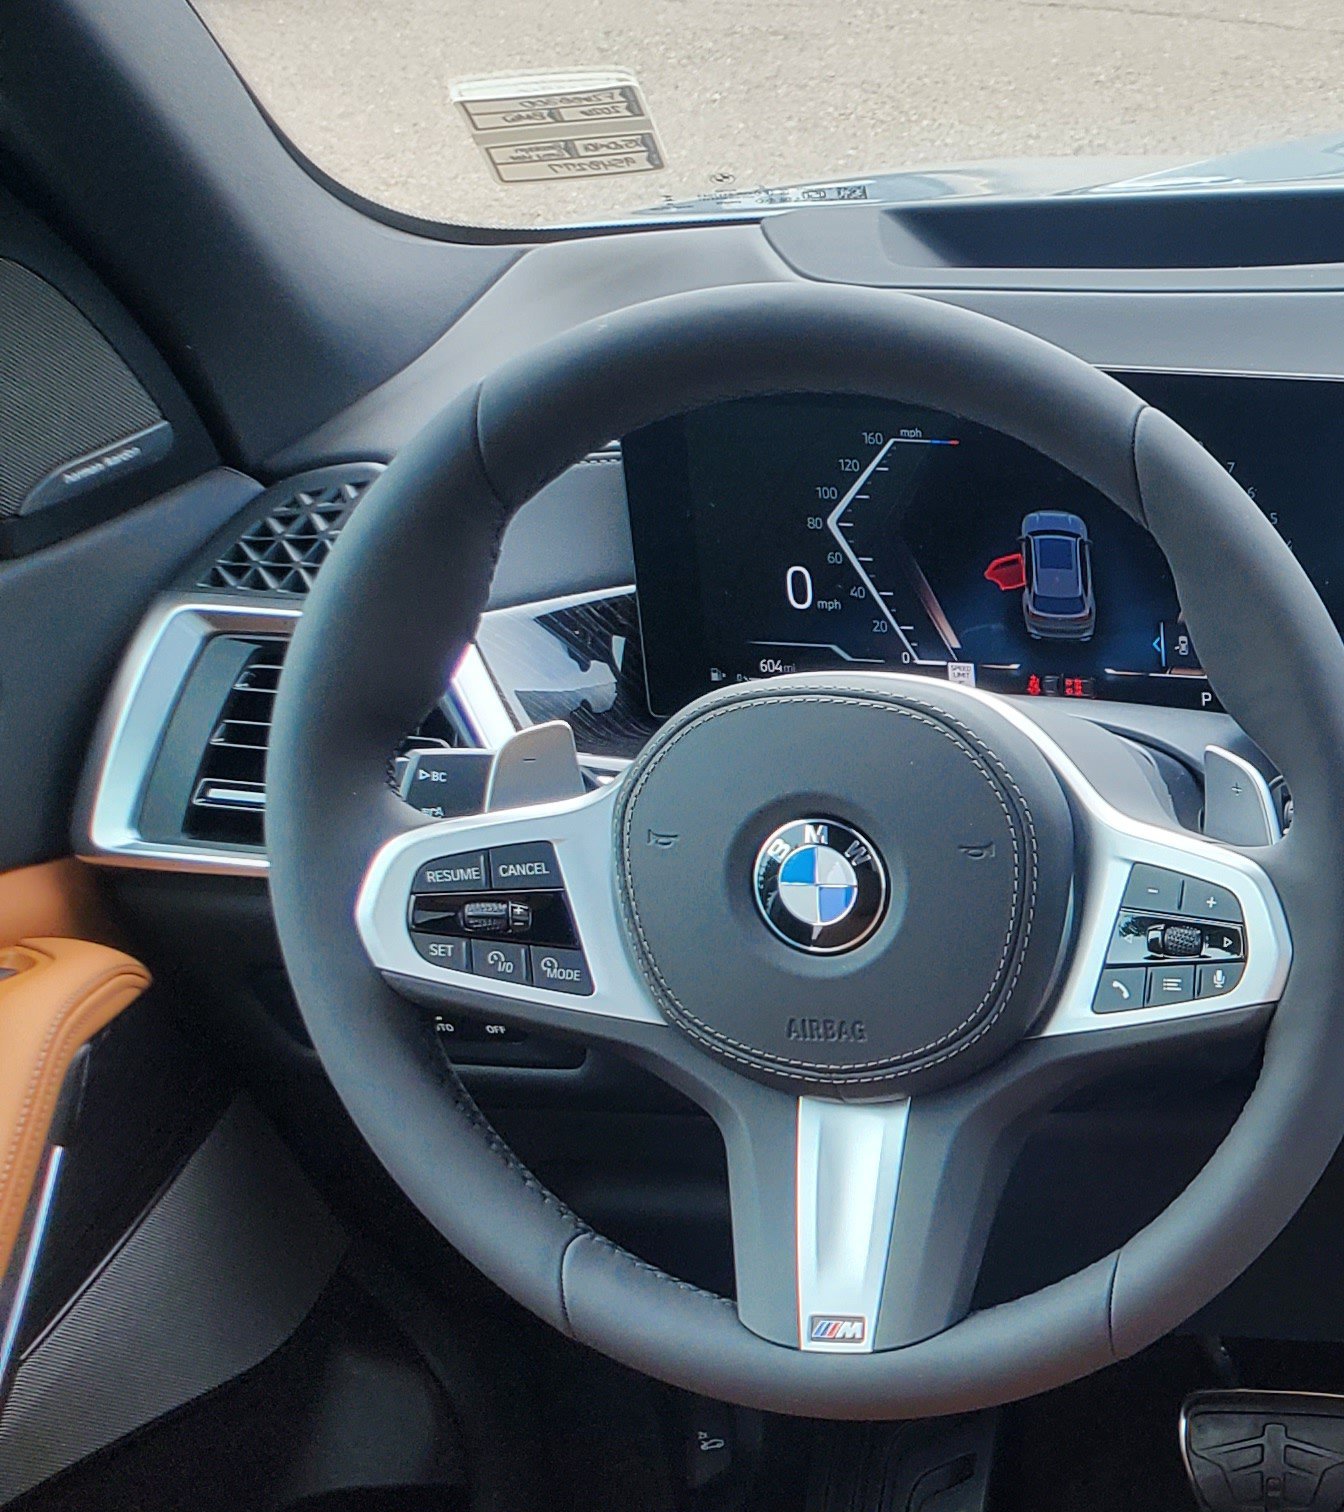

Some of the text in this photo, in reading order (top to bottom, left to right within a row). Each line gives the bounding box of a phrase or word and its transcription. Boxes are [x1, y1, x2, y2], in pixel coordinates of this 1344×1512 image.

[862, 432, 883, 445] 160
[900, 428, 922, 438] mph
[838, 459, 860, 472] 120
[816, 486, 838, 500] 100
[807, 517, 823, 530] 80
[827, 552, 843, 565] 60
[786, 566, 813, 609] 0
[850, 586, 866, 599] 40
[817, 599, 842, 612] mph
[872, 621, 888, 633] 20
[902, 652, 910, 664] 0
[1201, 692, 1212, 706] P
[431, 771, 448, 782] BC
[767, 824, 872, 867] BMW
[426, 867, 481, 883] RESUME
[499, 862, 550, 877] CANCEL
[429, 944, 454, 957] SET
[546, 966, 581, 981] MODE
[485, 1024, 506, 1034] OFF
[786, 1018, 867, 1042] AIRBAG
